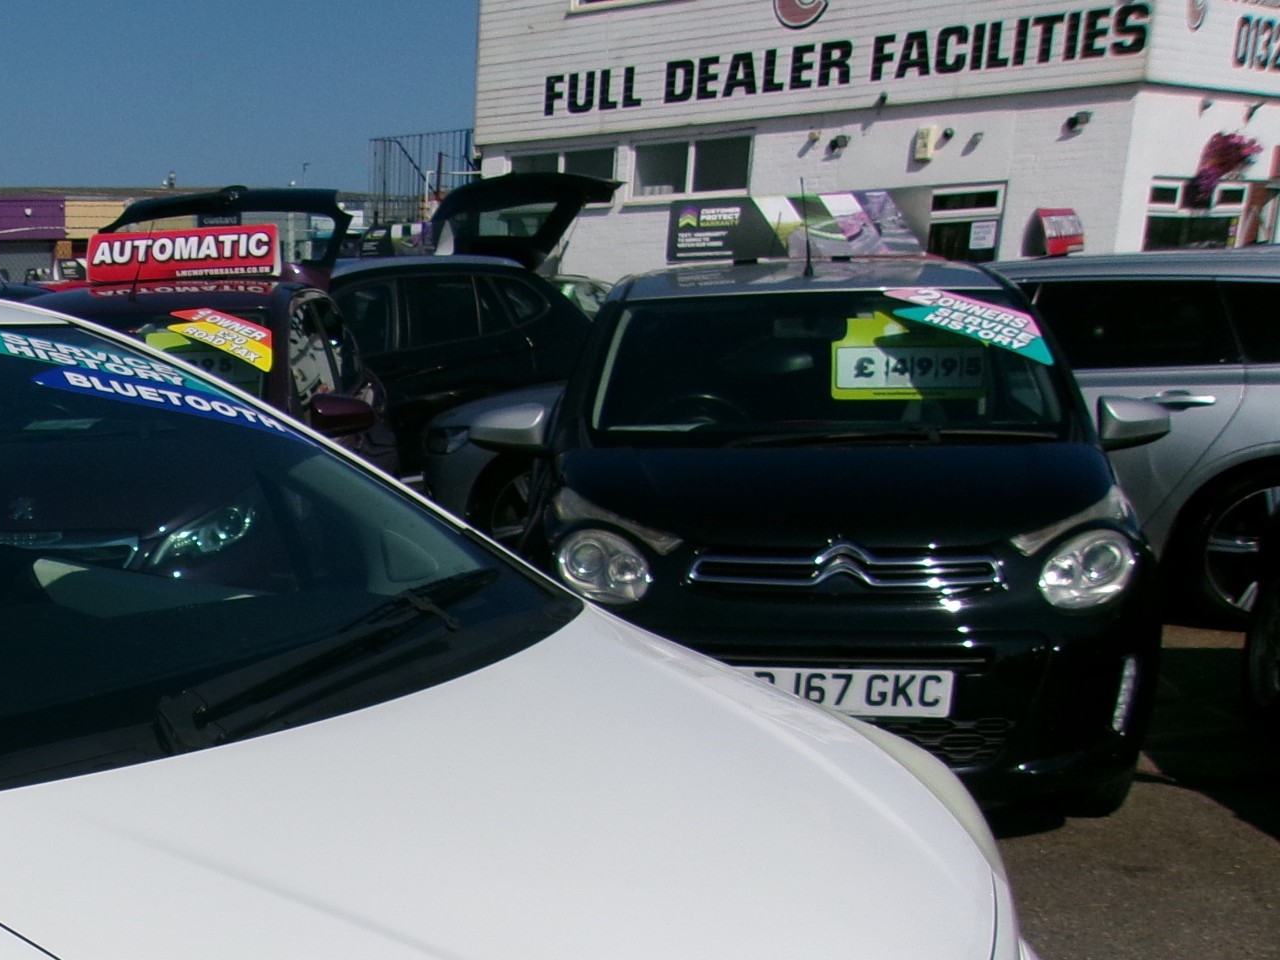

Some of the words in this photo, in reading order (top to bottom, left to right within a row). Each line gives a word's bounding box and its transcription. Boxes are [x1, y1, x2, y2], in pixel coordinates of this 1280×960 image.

[543, 66, 642, 117] FULL
[663, 39, 853, 104] DEALER
[870, 3, 1151, 82] FACILITIES
[700, 213, 741, 221] PROTECT
[91, 231, 269, 265] AUTOMATIC
[206, 314, 267, 340] OWNER
[909, 289, 942, 306] 2
[937, 296, 1031, 330] OWNERS
[934, 306, 1036, 344] SERVICE
[183, 326, 226, 346] ROAD
[228, 343, 262, 363] TAX
[924, 313, 1028, 350] HISTORY
[0, 332, 176, 375] SERVICE
[6, 343, 187, 387] HISTORY
[61, 370, 288, 433] BLUETOOTH
[865, 673, 943, 707] GKC
